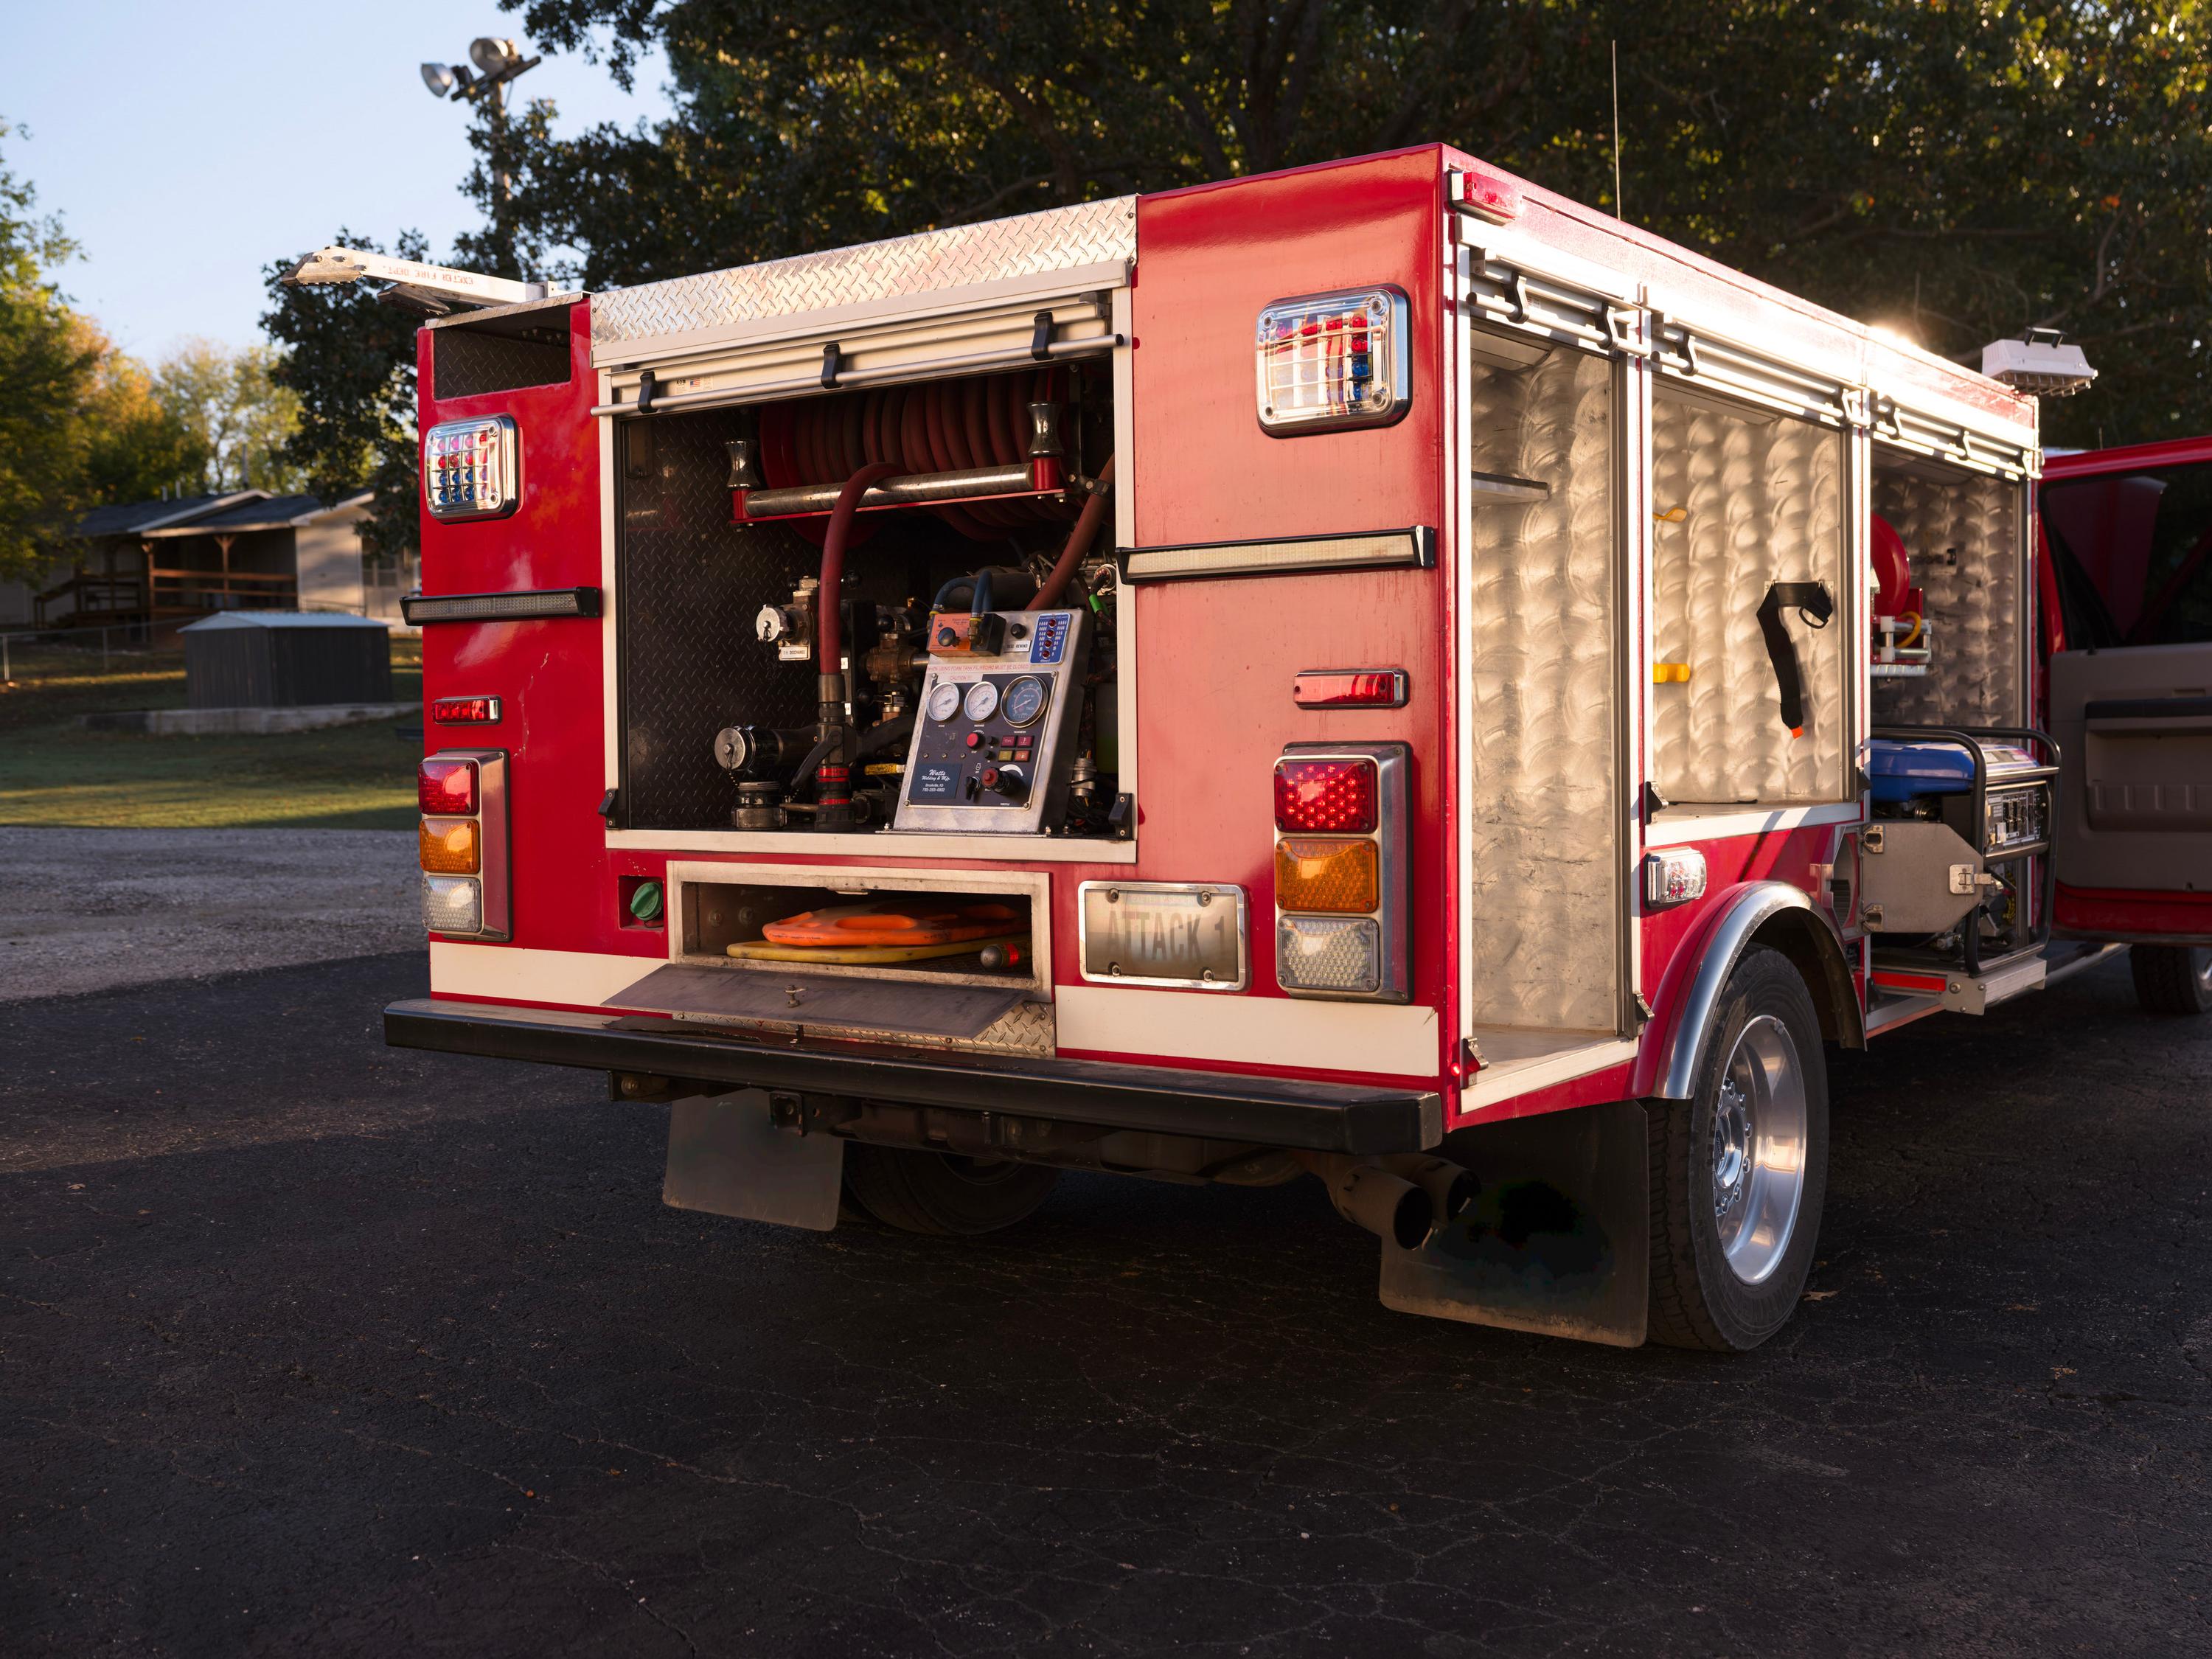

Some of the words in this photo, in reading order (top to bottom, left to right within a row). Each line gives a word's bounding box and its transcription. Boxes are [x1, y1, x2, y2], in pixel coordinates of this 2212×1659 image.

[414, 270, 437, 280] FIRE
[442, 274, 474, 285] EXETER
[1106, 910, 1204, 963] ATTACK
[1214, 915, 1225, 961] 1
